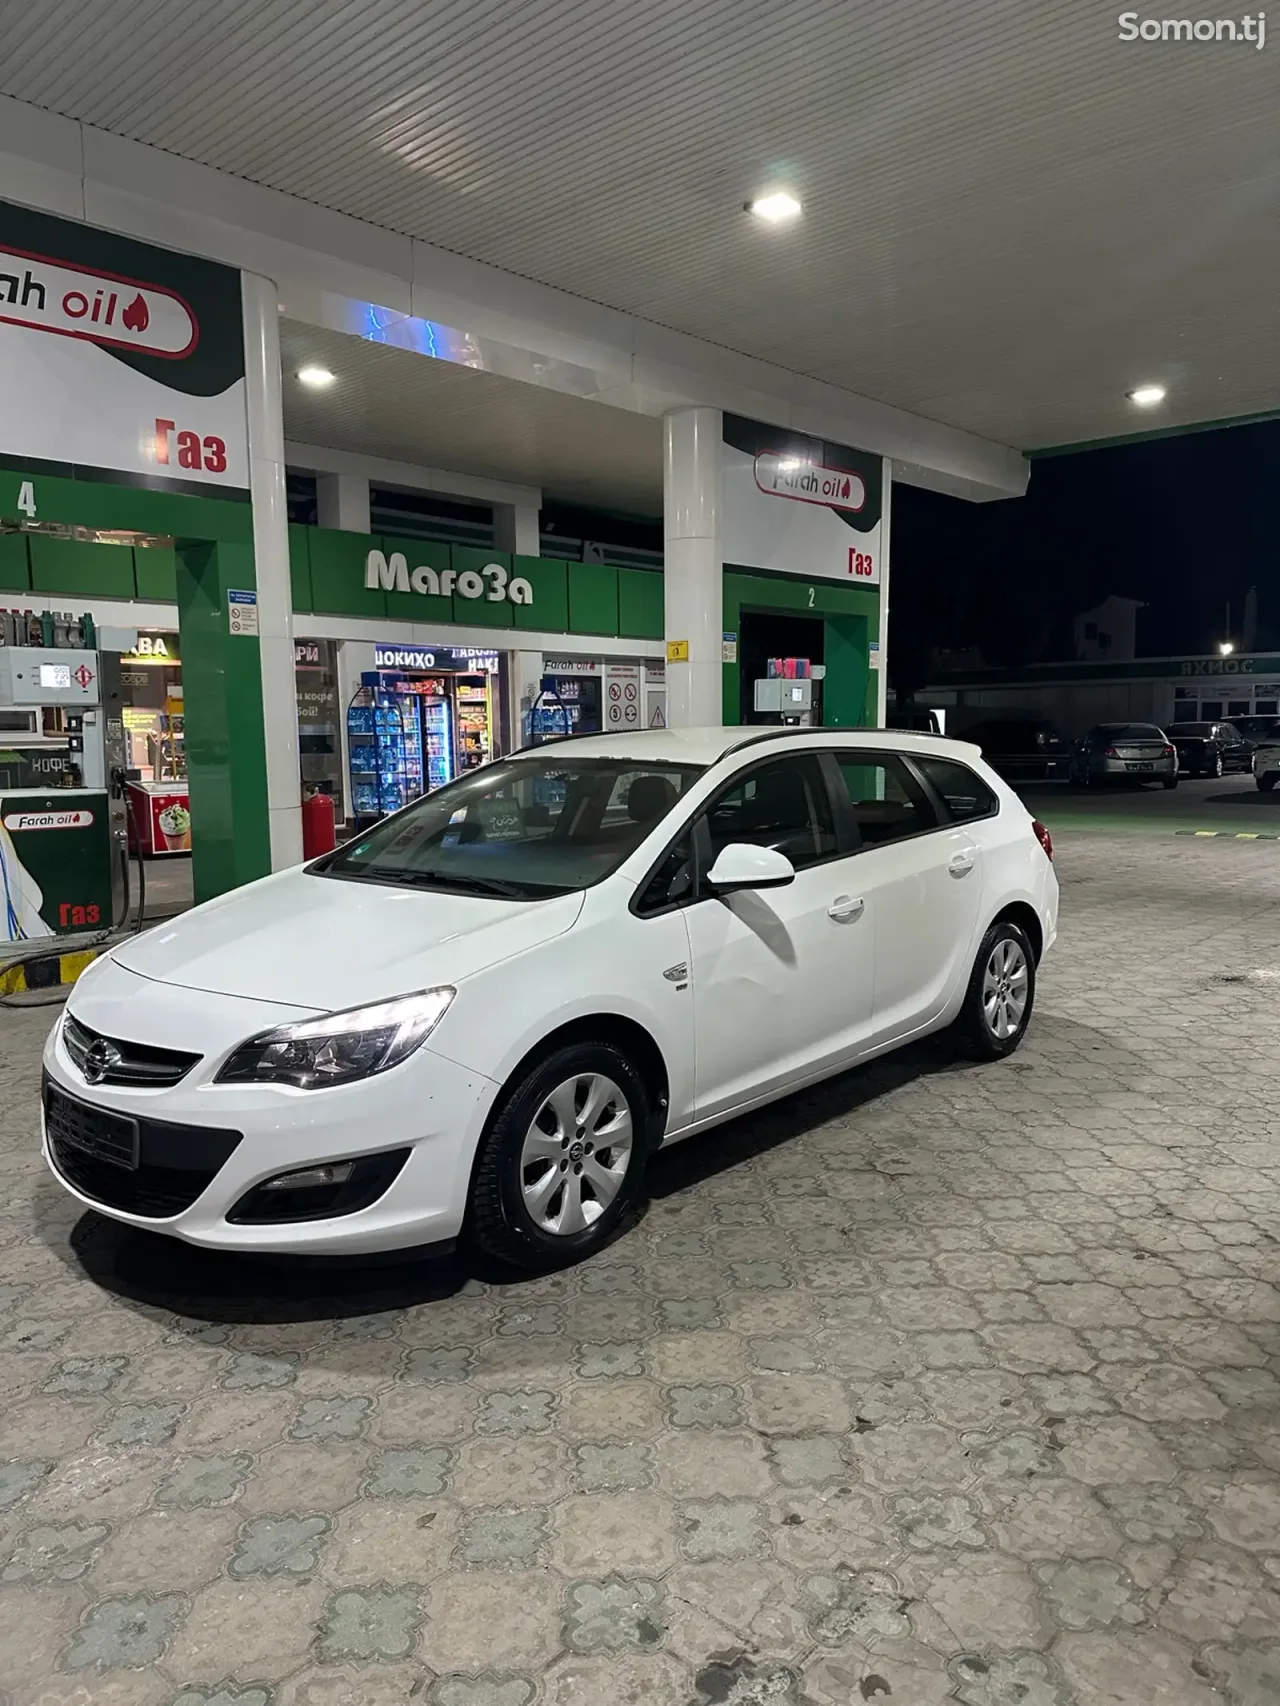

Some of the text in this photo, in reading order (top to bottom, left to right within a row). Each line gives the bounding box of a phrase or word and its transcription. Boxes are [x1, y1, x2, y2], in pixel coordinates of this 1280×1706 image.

[62, 290, 117, 325] oil
[155, 418, 227, 473] Газ
[822, 477, 841, 497] oil
[17, 481, 36, 517] 4
[848, 547, 873, 577] Газ
[808, 587, 815, 607] 2
[544, 660, 588, 671] Farah oil
[1180, 659, 1254, 676] ЯХМОС
[304, 692, 333, 703] кофе
[613, 708, 618, 718] 5
[32, 757, 70, 773] КОФЕ
[18, 814, 73, 828] Farah oil
[59, 903, 100, 926] Газ
